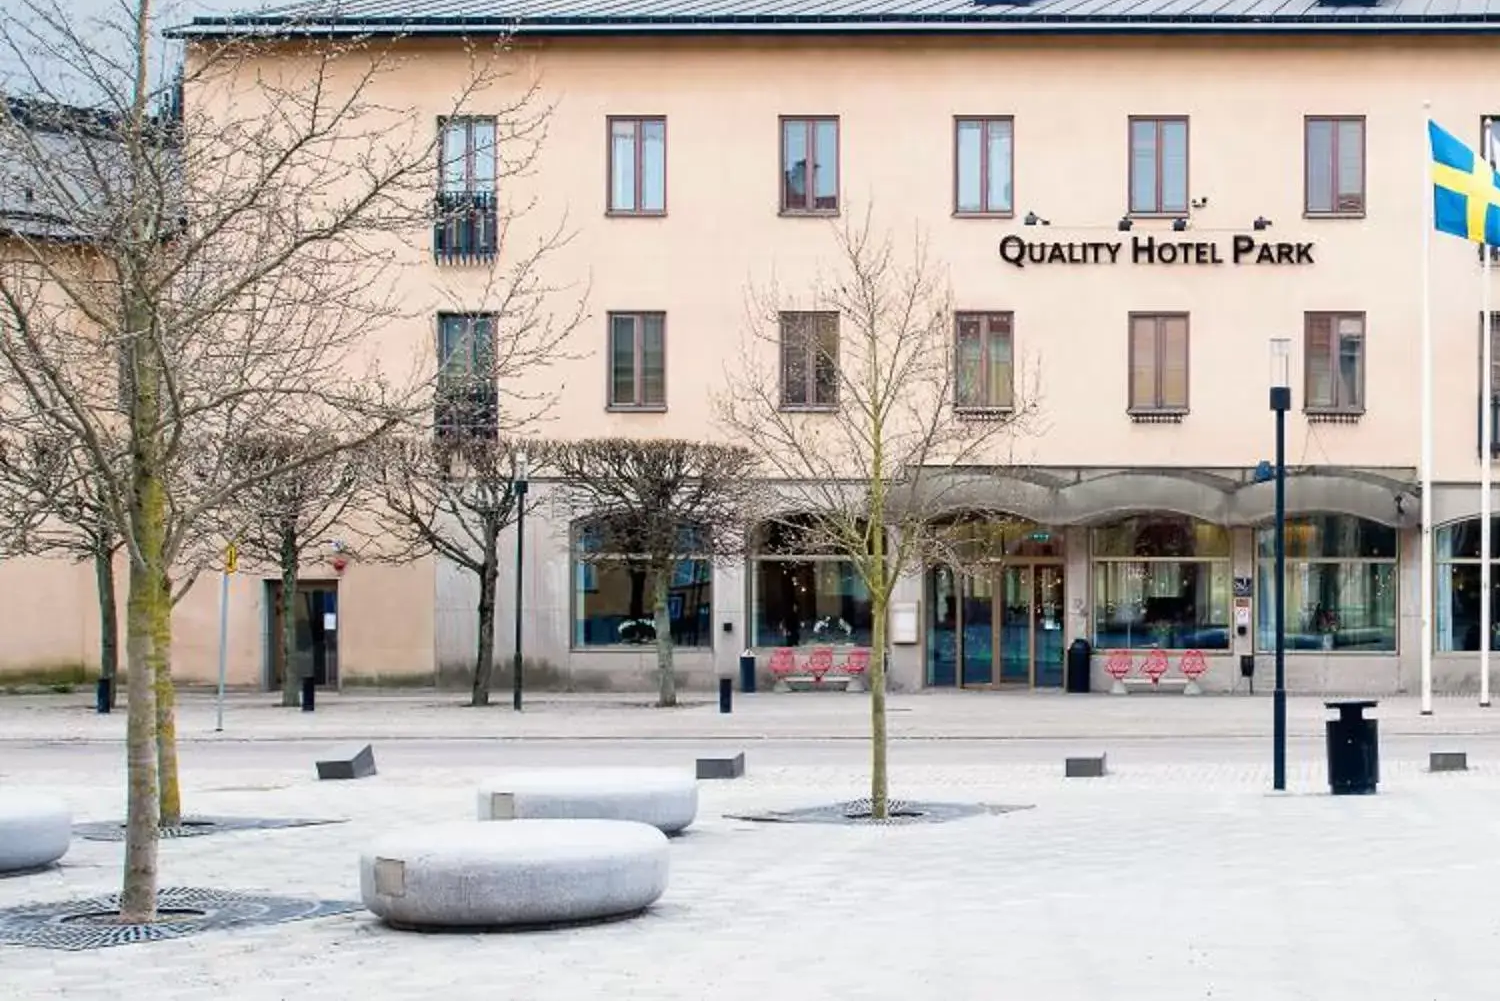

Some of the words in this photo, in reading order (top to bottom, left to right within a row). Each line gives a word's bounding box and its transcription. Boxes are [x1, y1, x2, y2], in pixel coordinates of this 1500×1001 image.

[1000, 235, 1122, 268] QUALITY
[1132, 235, 1223, 264] HOTEL
[1234, 235, 1315, 264] PARK
